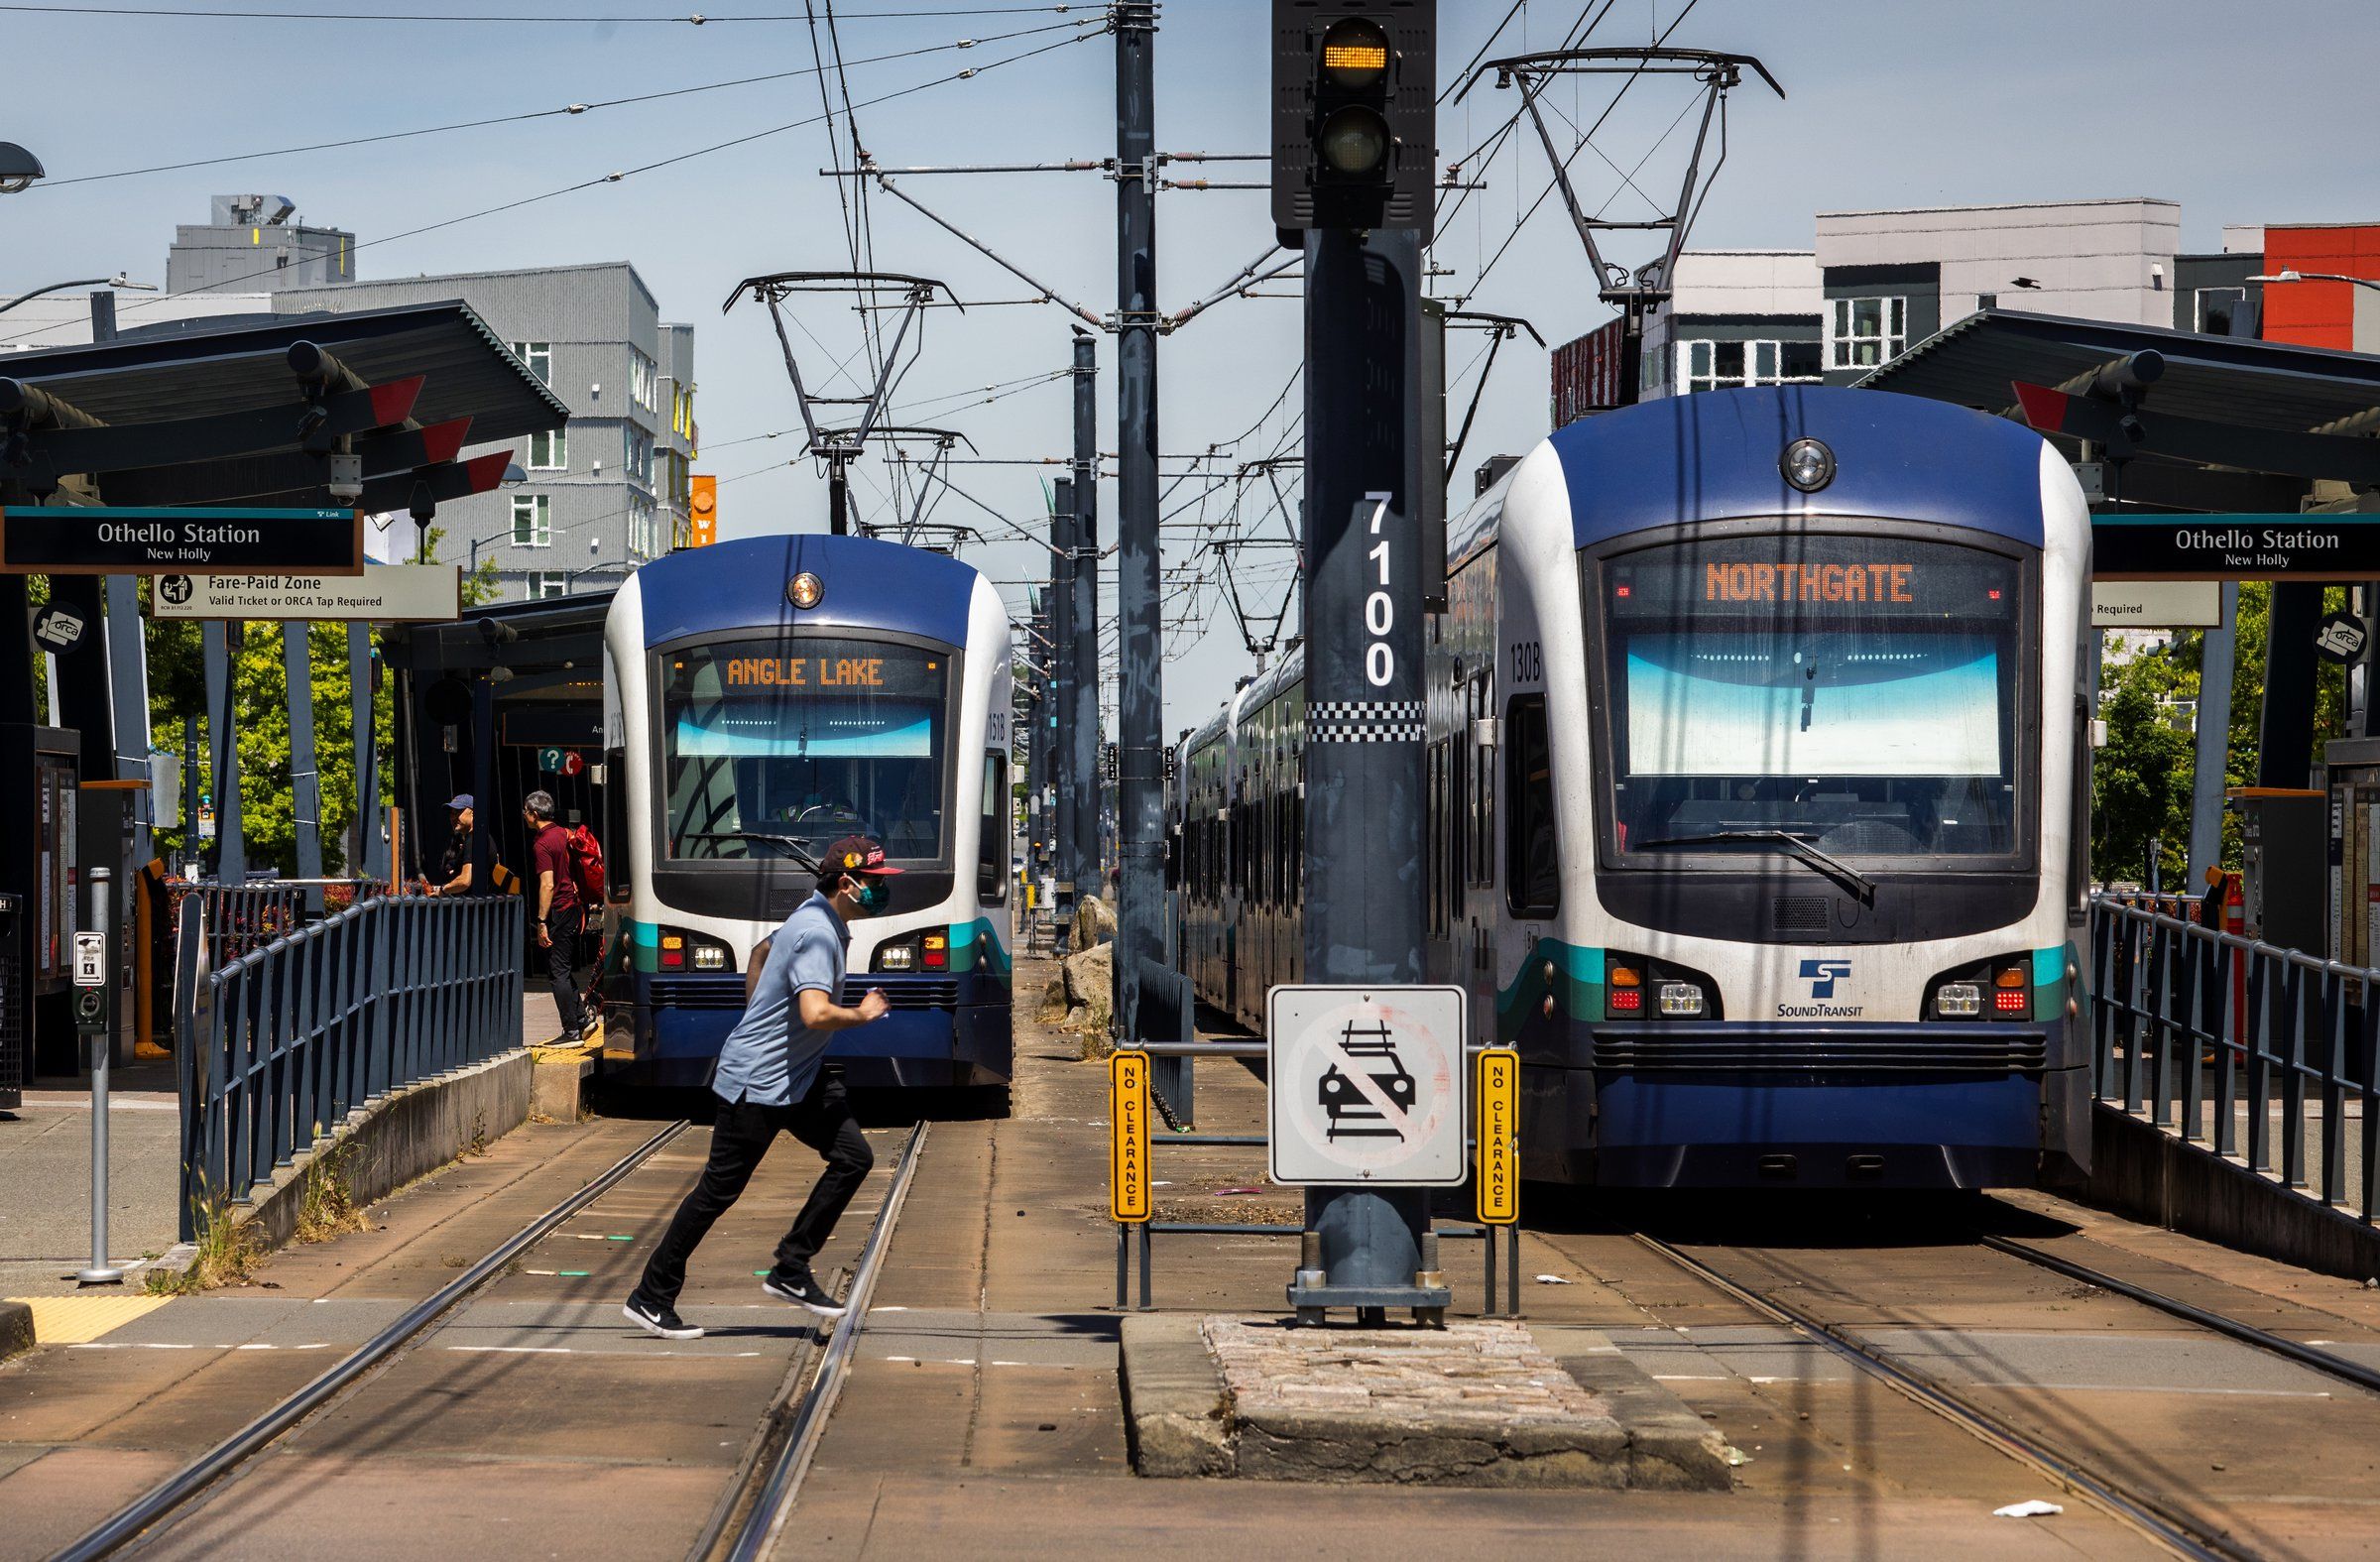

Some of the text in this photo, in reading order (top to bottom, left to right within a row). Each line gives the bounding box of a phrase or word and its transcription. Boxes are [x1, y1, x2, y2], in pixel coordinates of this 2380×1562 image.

[97, 523, 260, 543] Othello Station
[2175, 529, 2339, 549] Othello Station
[147, 547, 211, 562] New Holly
[2224, 553, 2290, 568] New Holly
[208, 575, 321, 590] Fare-Paid Zone
[1365, 491, 1394, 687] 7100
[1706, 562, 1913, 602] NORTHGATE
[208, 595, 234, 606] Valid
[238, 596, 268, 606] Ticket
[285, 596, 313, 607] ORCA
[316, 597, 334, 609] Tap
[337, 597, 383, 609] Required
[2096, 603, 2143, 617] Required
[55, 622, 78, 637] orca
[2335, 632, 2359, 648] orca
[727, 659, 885, 685] ANGLE LAKE
[1510, 641, 1541, 683] 130B
[989, 712, 1006, 742] 151B
[1125, 1067, 1135, 1206] NO CLEARANCE
[1492, 1066, 1503, 1207] NO CLEARANCE
